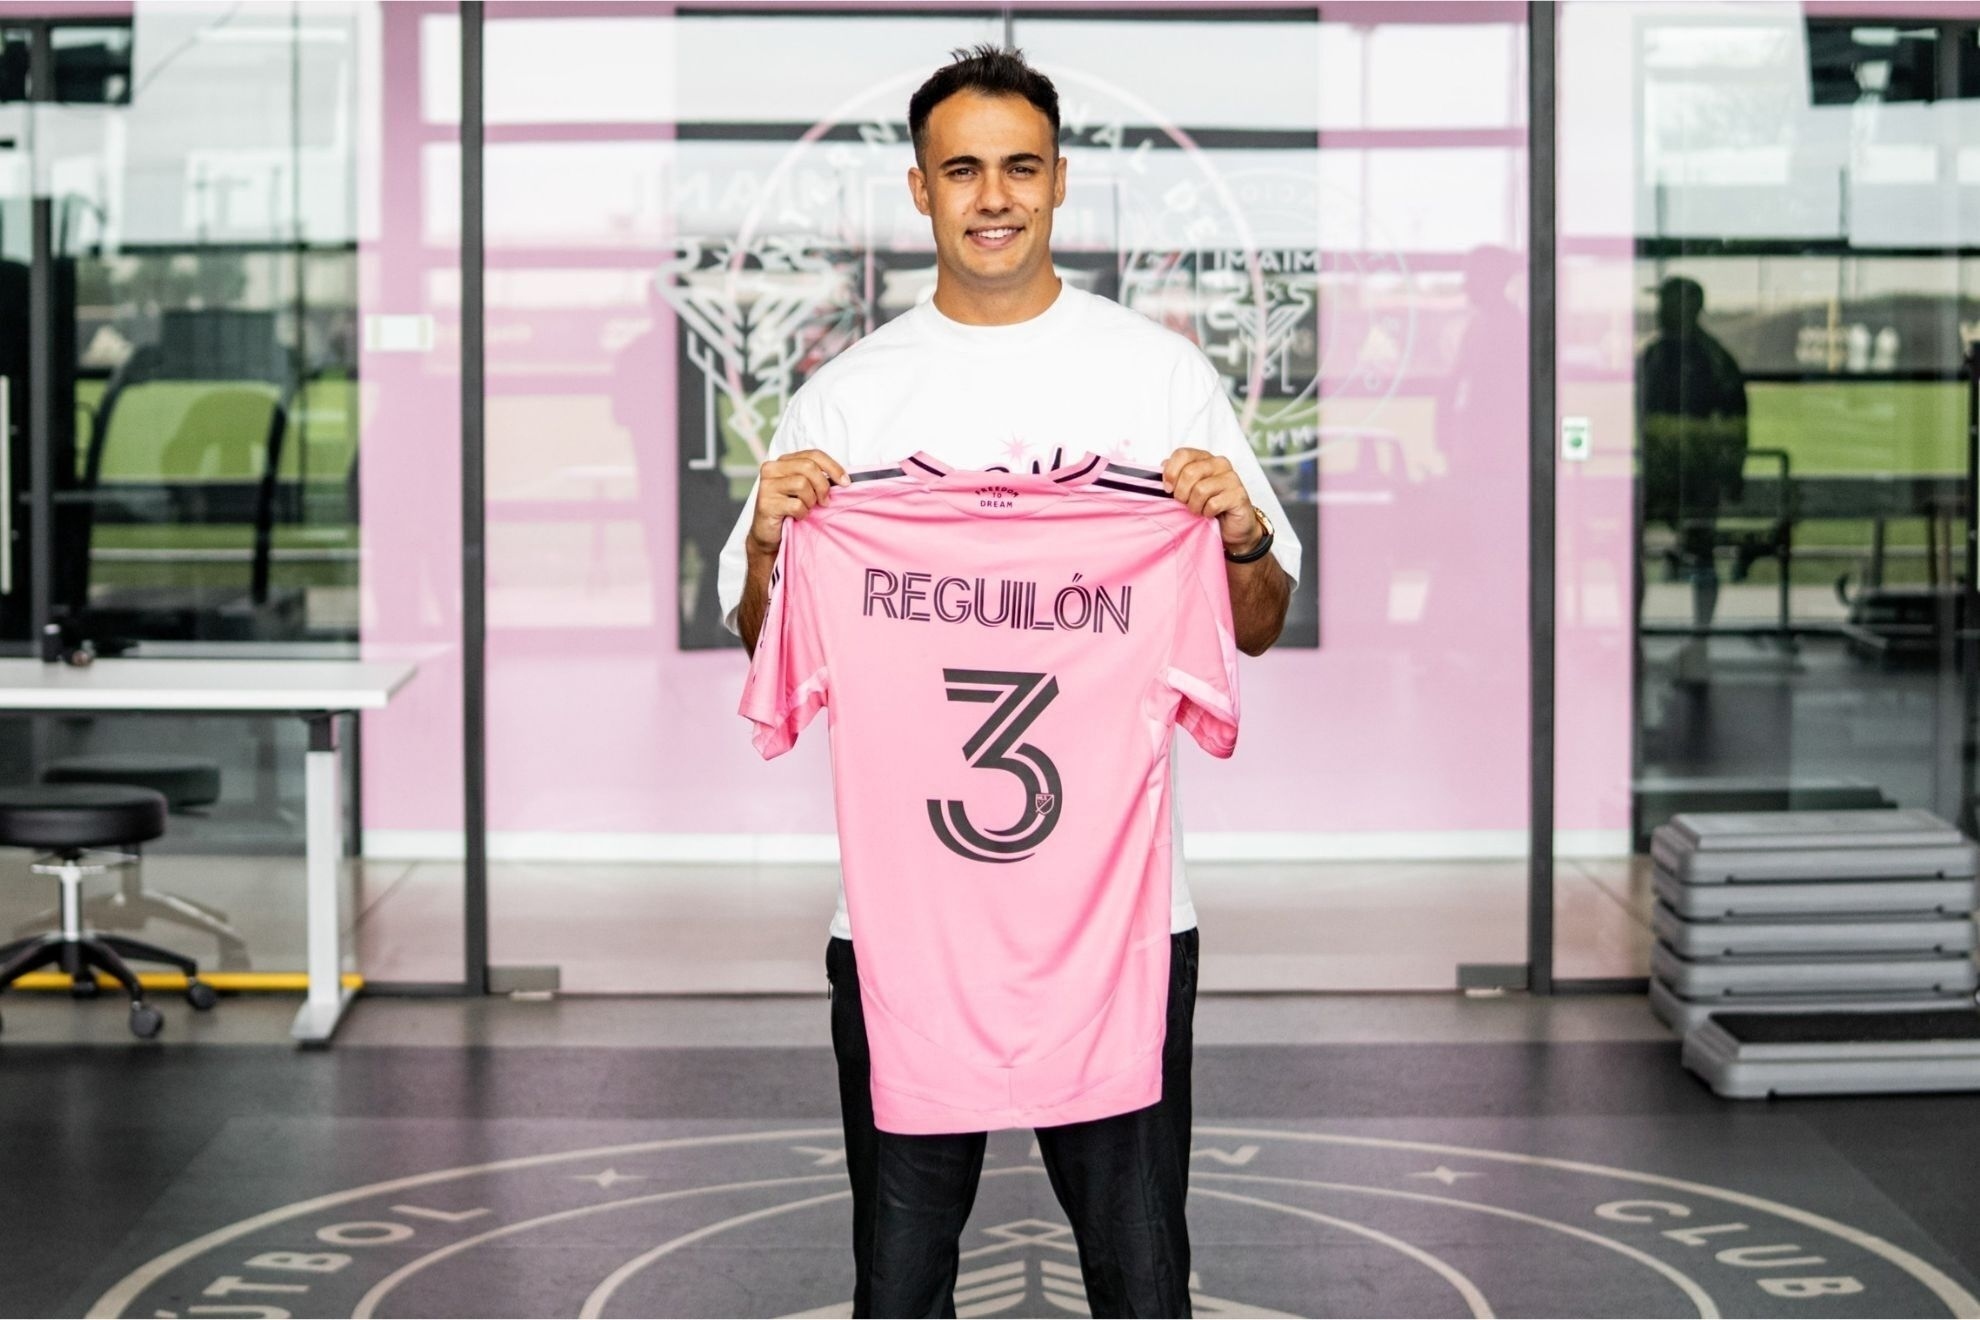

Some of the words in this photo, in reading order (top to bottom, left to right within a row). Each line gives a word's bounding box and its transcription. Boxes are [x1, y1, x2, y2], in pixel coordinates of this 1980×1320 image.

[975, 486, 1019, 497] FREEDOM
[980, 500, 1013, 508] DREAM
[862, 568, 1132, 635] REGUILÓN
[926, 667, 1063, 864] 3
[154, 1205, 492, 1319] ÚTBOL
[1594, 1200, 1865, 1298] CLUB
